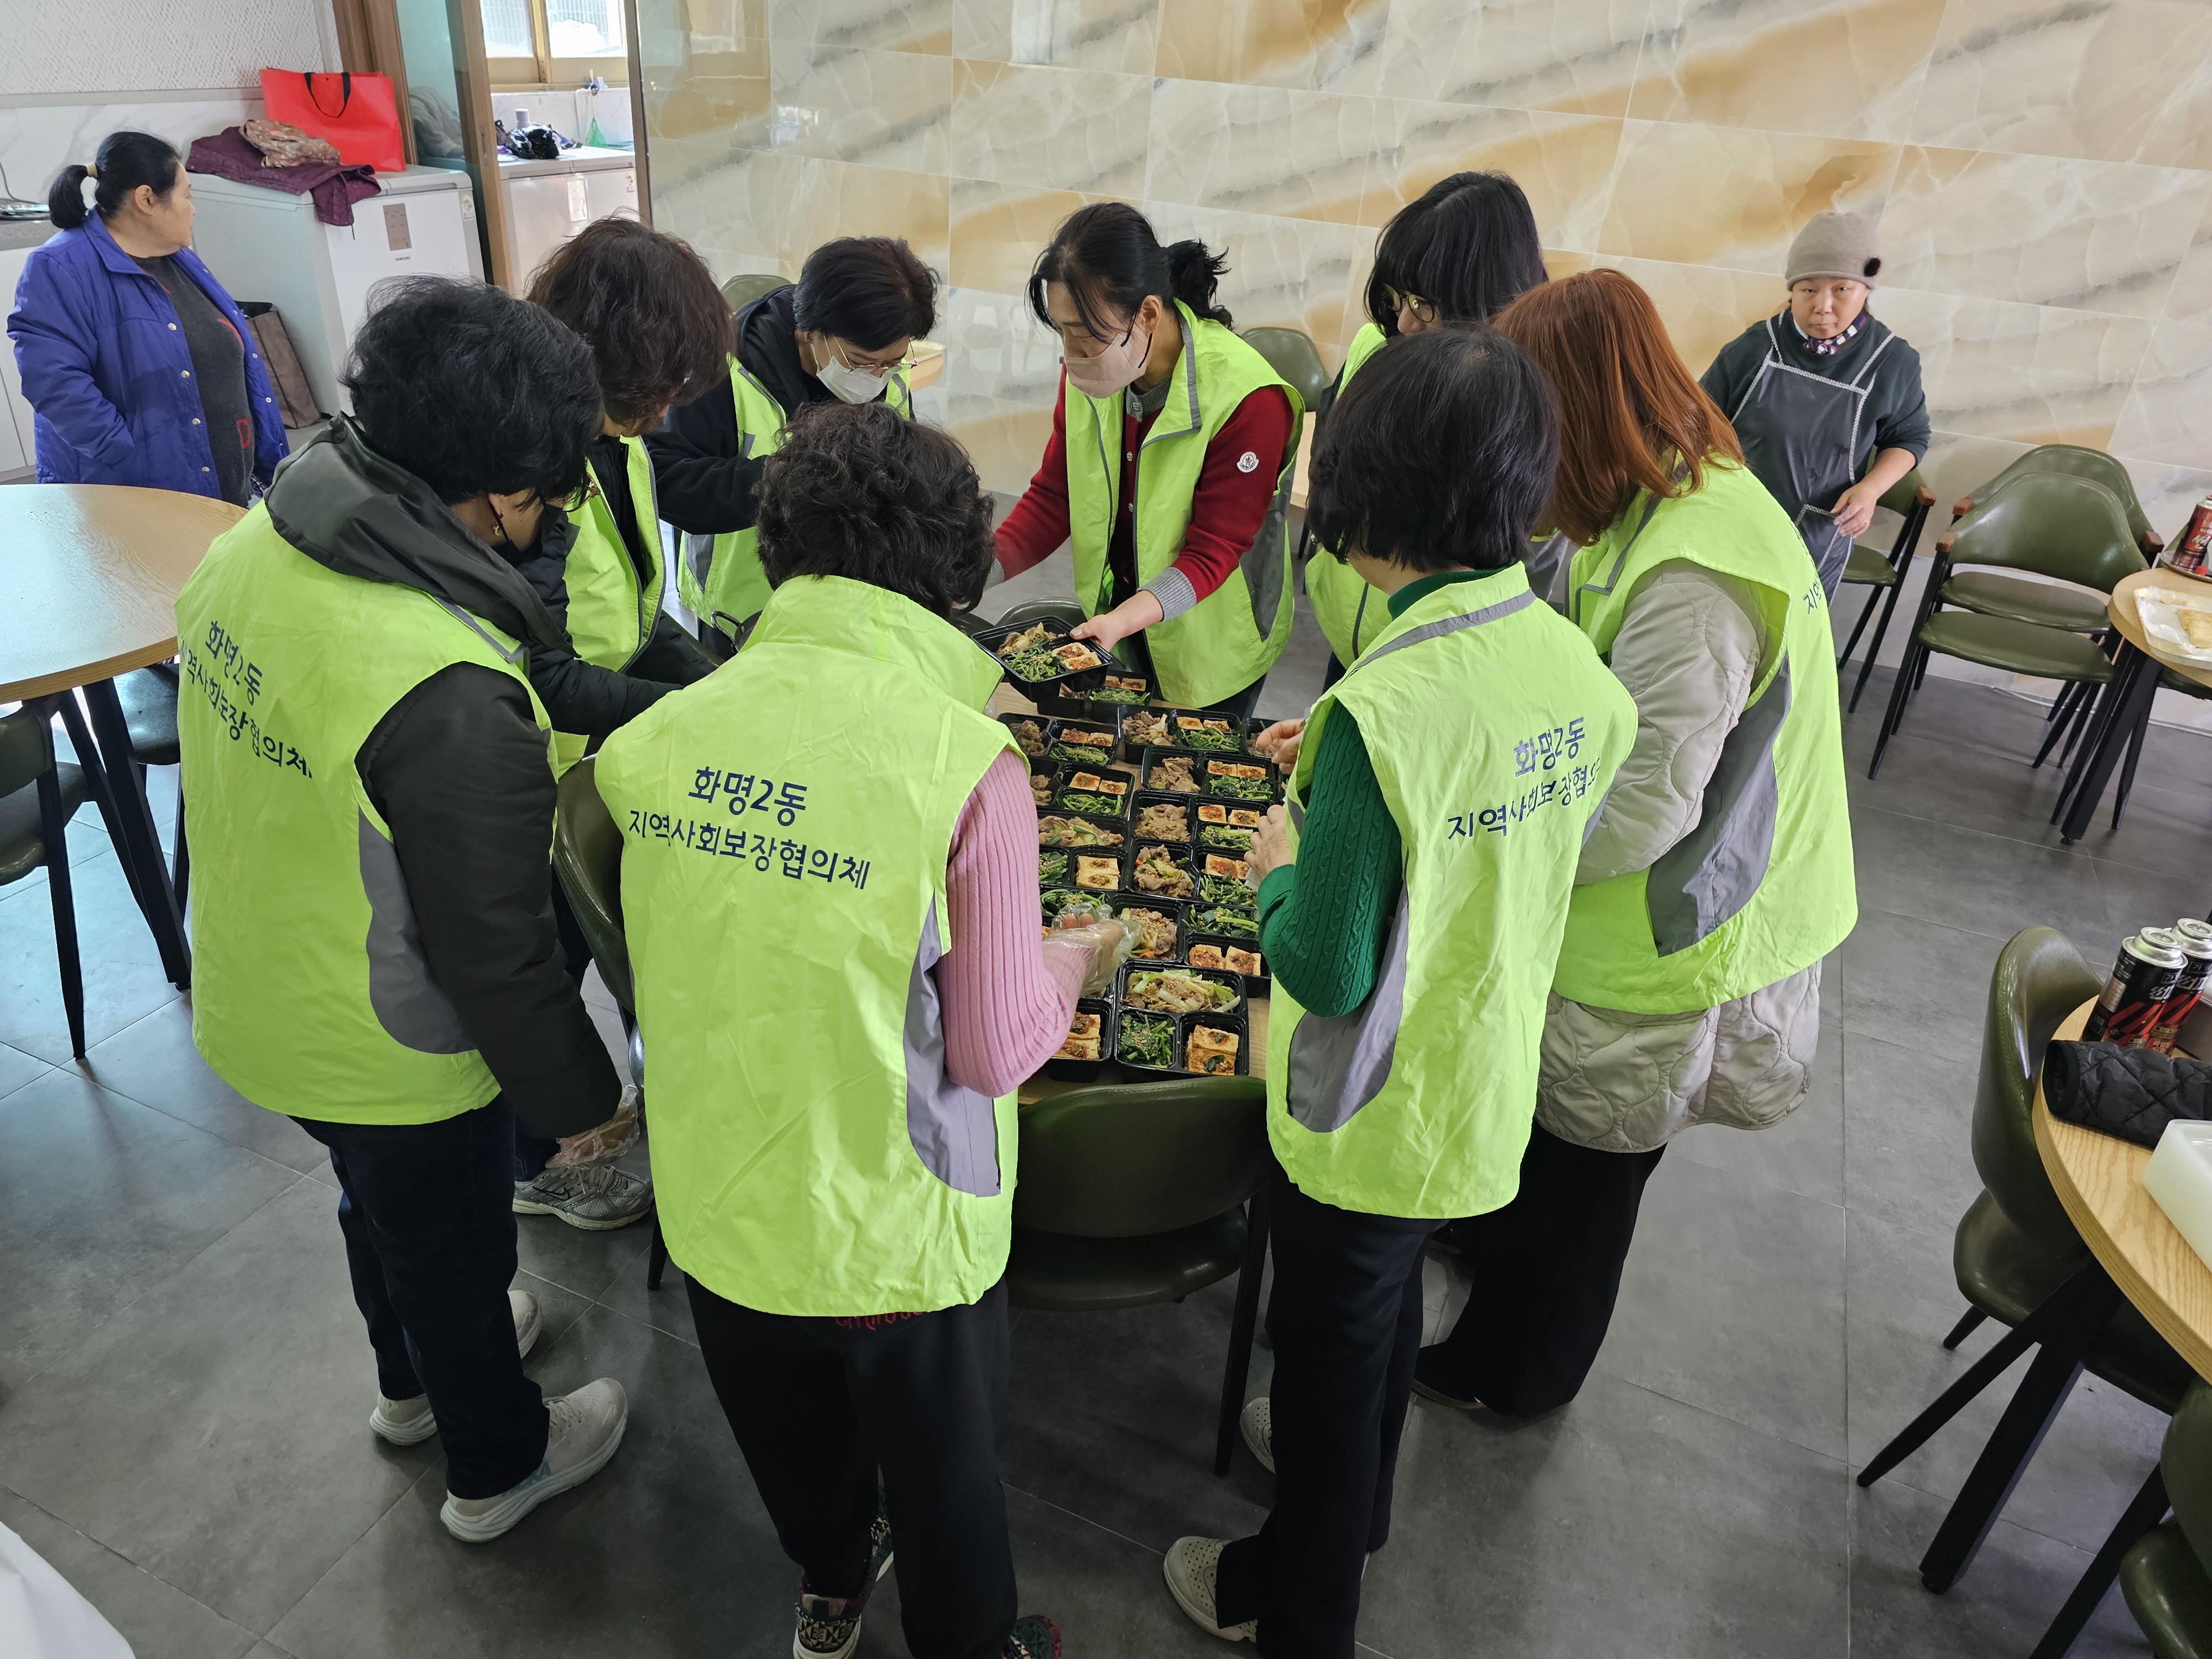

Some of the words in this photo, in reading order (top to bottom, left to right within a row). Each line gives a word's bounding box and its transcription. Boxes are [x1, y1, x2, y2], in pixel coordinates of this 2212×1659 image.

[205, 619, 263, 706] 화명2동
[1513, 717, 1585, 778] 화명2동
[688, 766, 808, 827] 화명2동
[629, 810, 871, 890] 지역사회보장협의체
